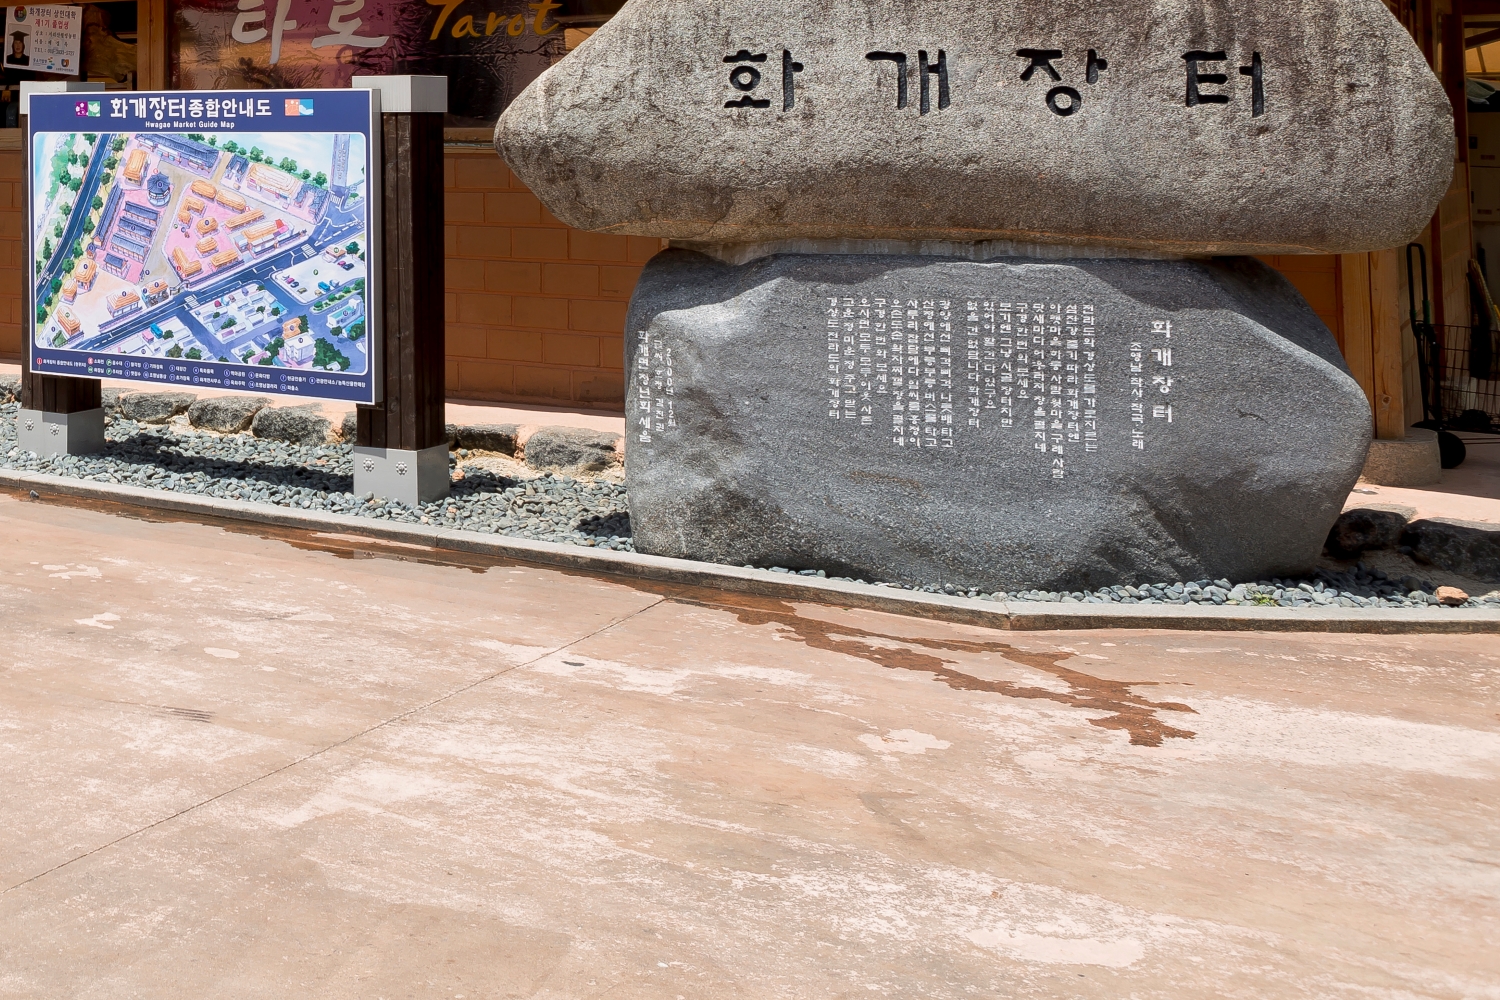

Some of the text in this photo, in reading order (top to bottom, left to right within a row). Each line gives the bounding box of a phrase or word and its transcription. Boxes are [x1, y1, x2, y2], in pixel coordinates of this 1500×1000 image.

[29, 7, 76, 19] 화개장터 상인대학
[35, 19, 69, 30] 제1기 졸업생
[723, 47, 1266, 117] 화개장터
[145, 121, 171, 129] Hwagae
[221, 121, 235, 129] Map
[843, 298, 854, 317] 고운
[858, 298, 870, 328] 오시면
[875, 298, 886, 318] 구경
[891, 299, 902, 340] 오손도손
[907, 299, 919, 330] 사투리
[939, 300, 951, 342] 광양에선
[967, 301, 978, 321] 없을
[983, 301, 995, 333] 있어야
[1000, 303, 1011, 333] 보기엔
[1016, 303, 1028, 323] 구경
[1033, 304, 1045, 345] 닷새마다
[1050, 304, 1061, 345] 아랫마을
[827, 297, 840, 419] 경상도 전라도의 화개장터
[844, 336, 855, 355] 미운
[859, 333, 871, 353] 모두
[908, 334, 919, 376] 잡담에다
[1000, 338, 1012, 357] 그냥
[860, 357, 871, 377] 모두
[876, 363, 887, 393] 보세요
[1083, 305, 1097, 452] 전라도와 경상도를 가로지르는
[1151, 320, 1173, 422] 화개장터
[844, 374, 856, 393] 주고
[985, 377, 996, 408] 있구요
[1017, 368, 1029, 398] 보세요
[893, 391, 904, 410] 장을
[924, 392, 936, 423] 버스를
[941, 392, 952, 424] 나룻배
[968, 386, 980, 428] 화개장터
[1034, 396, 1046, 416] 장을
[1050, 398, 1063, 429] 윗마을
[1067, 389, 1079, 442] 화개장터엔
[639, 417, 651, 442] 세움
[909, 415, 920, 447] 흥정이
[925, 427, 937, 446] 타고
[942, 427, 953, 447] 타고
